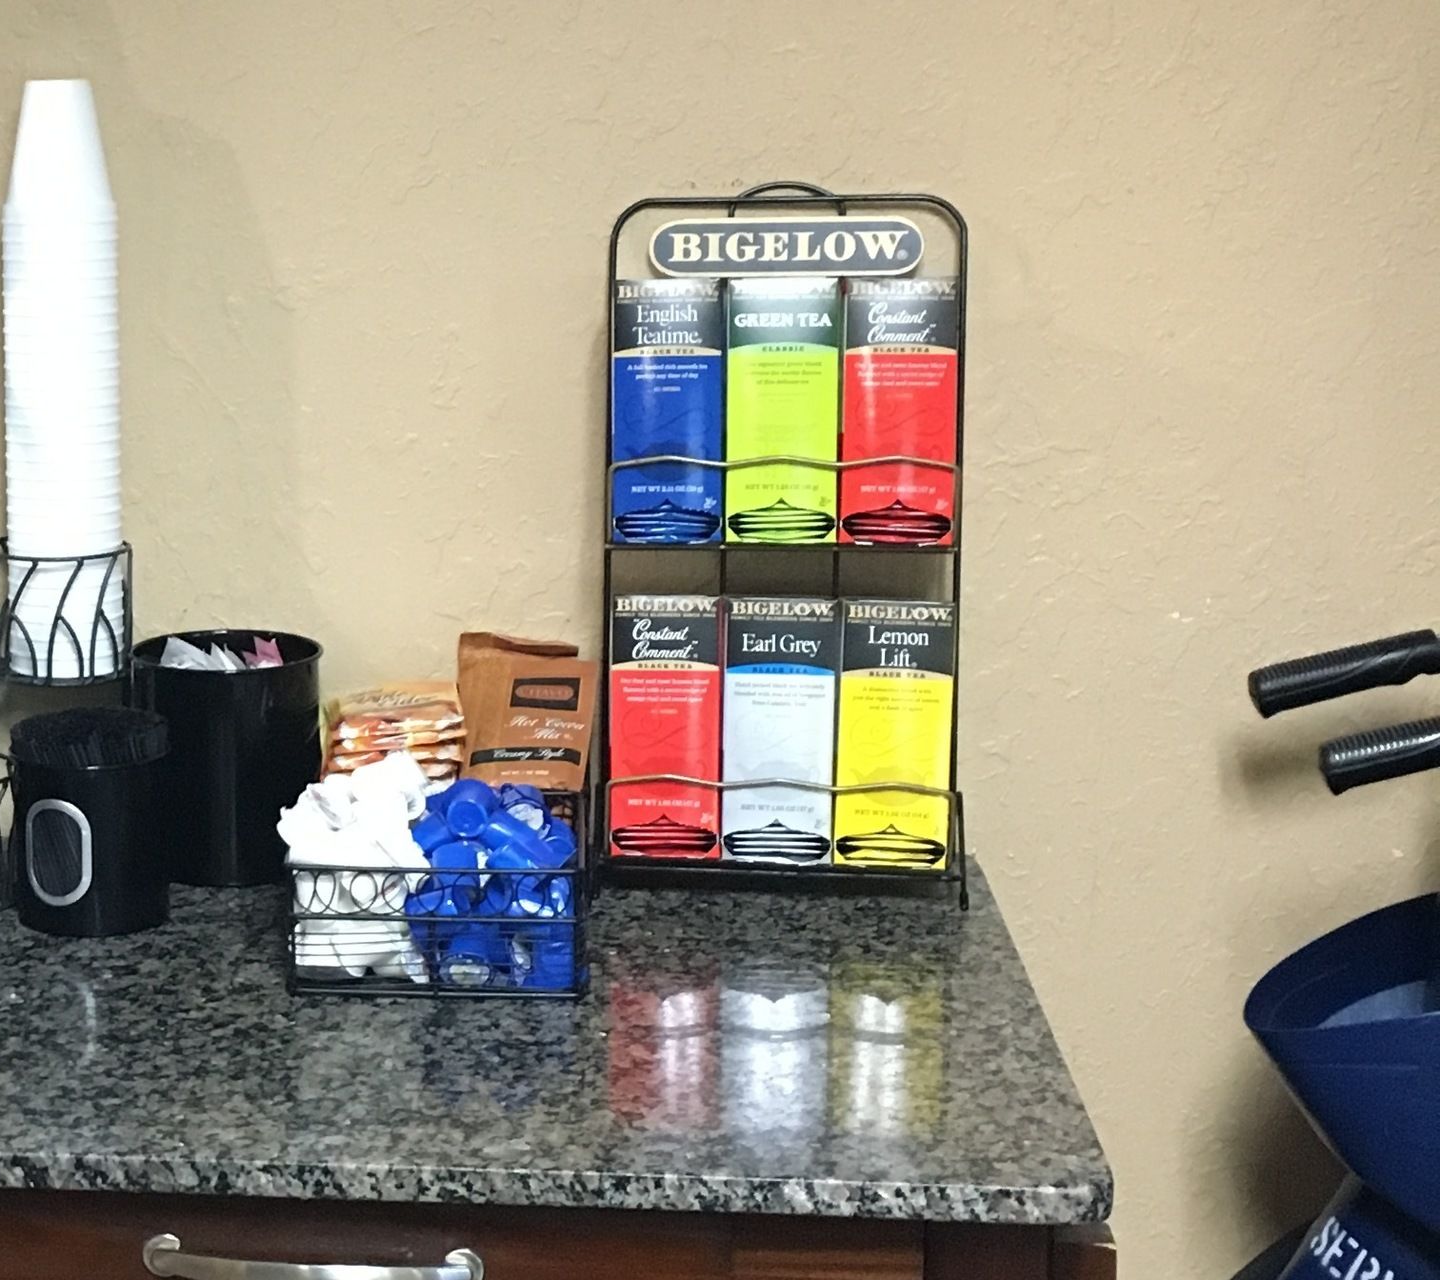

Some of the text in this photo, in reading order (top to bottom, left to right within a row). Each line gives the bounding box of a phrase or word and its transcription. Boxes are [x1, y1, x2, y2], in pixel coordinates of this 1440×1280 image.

[668, 231, 909, 262] BIGELOW
[636, 304, 698, 326] English
[734, 312, 833, 328] GREEN TEA
[632, 325, 700, 345] Teatime
[616, 598, 717, 612] BIGELOW
[731, 601, 834, 616] BIGELOW
[848, 604, 953, 621] BIGELOW
[868, 625, 929, 646] Lemon
[742, 633, 822, 658] Earl Grey
[880, 647, 910, 667] Lift
[544, 717, 585, 730] Cocoa
[493, 748, 533, 760] Creamy
